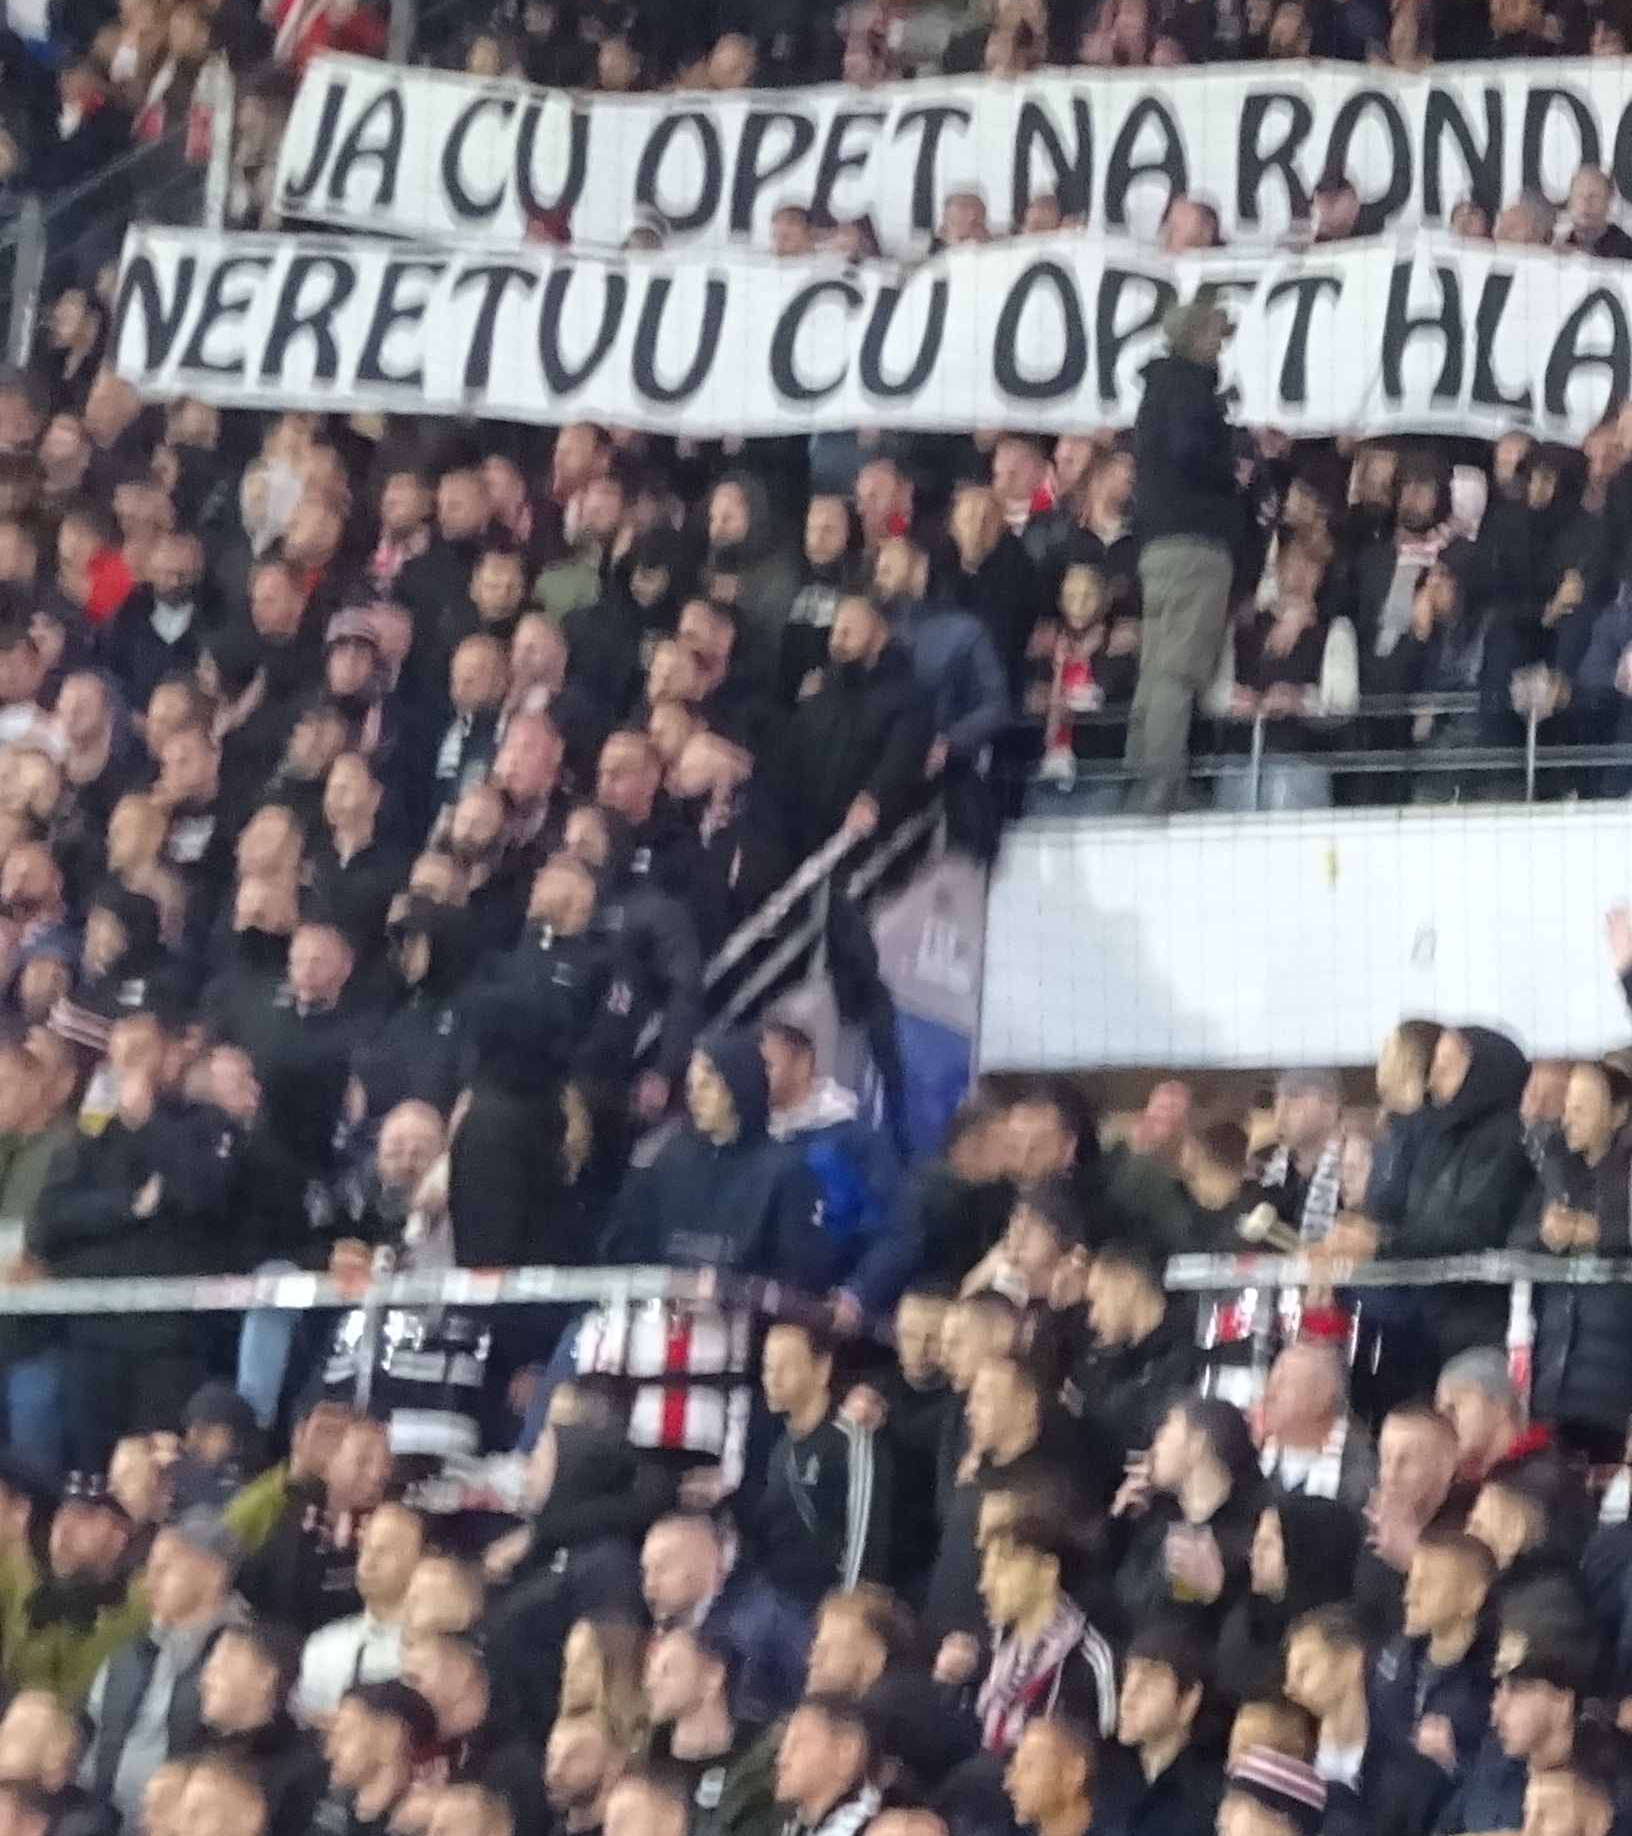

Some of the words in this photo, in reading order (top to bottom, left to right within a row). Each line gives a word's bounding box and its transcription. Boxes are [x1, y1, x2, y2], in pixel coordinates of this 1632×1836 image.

[285, 82, 406, 206] JA
[441, 97, 588, 220] CU
[636, 107, 970, 232] OPET
[1013, 87, 1192, 230] NA
[769, 277, 950, 400] CU
